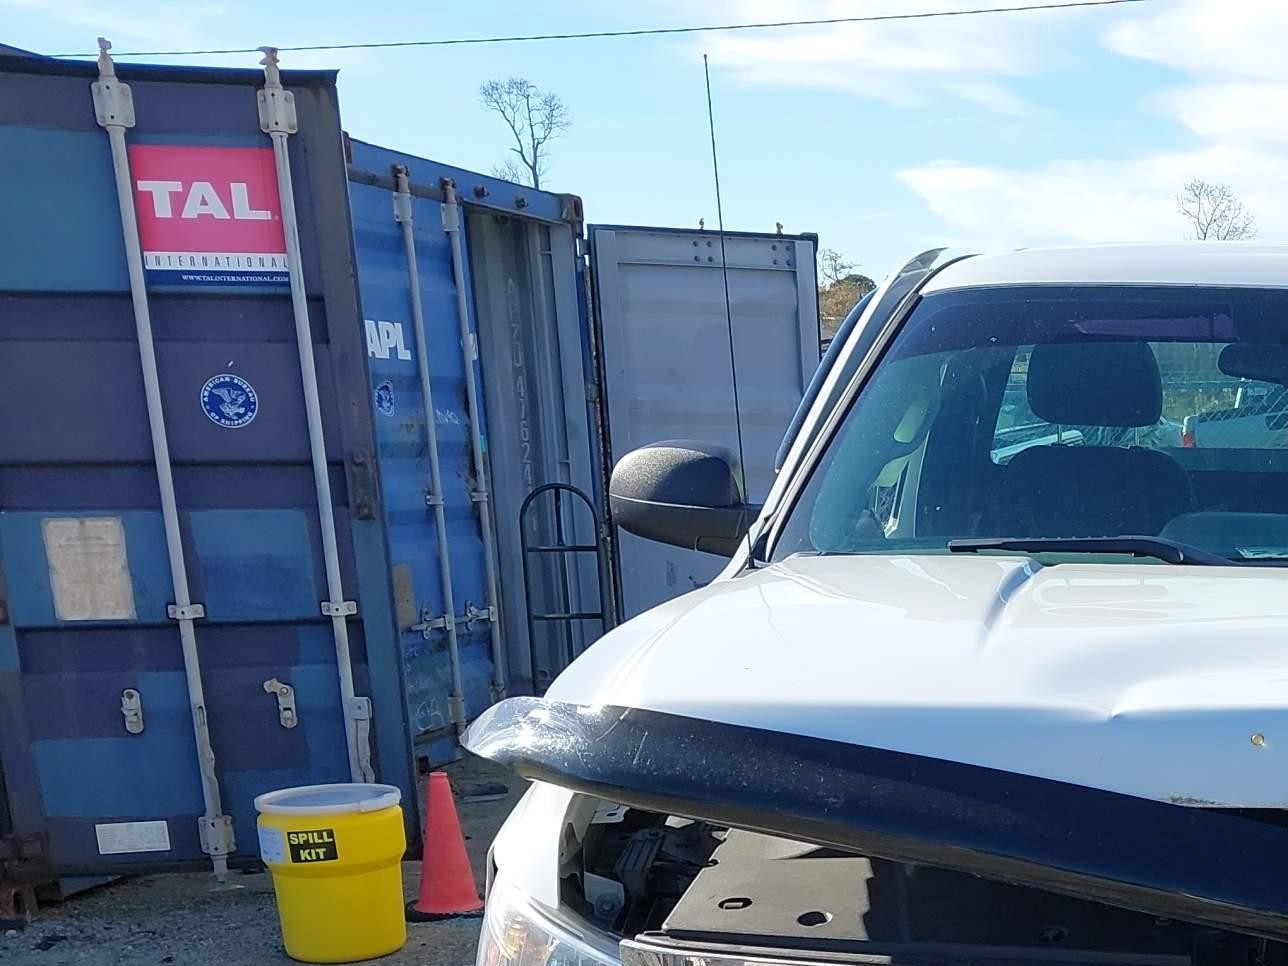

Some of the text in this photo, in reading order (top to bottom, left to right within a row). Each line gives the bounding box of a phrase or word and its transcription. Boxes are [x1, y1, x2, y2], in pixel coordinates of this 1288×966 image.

[137, 180, 272, 220] TAL
[144, 255, 288, 268] INTERNATIONAL
[364, 319, 412, 360] APL
[289, 832, 333, 845] SPILL
[300, 848, 326, 860] KIT
